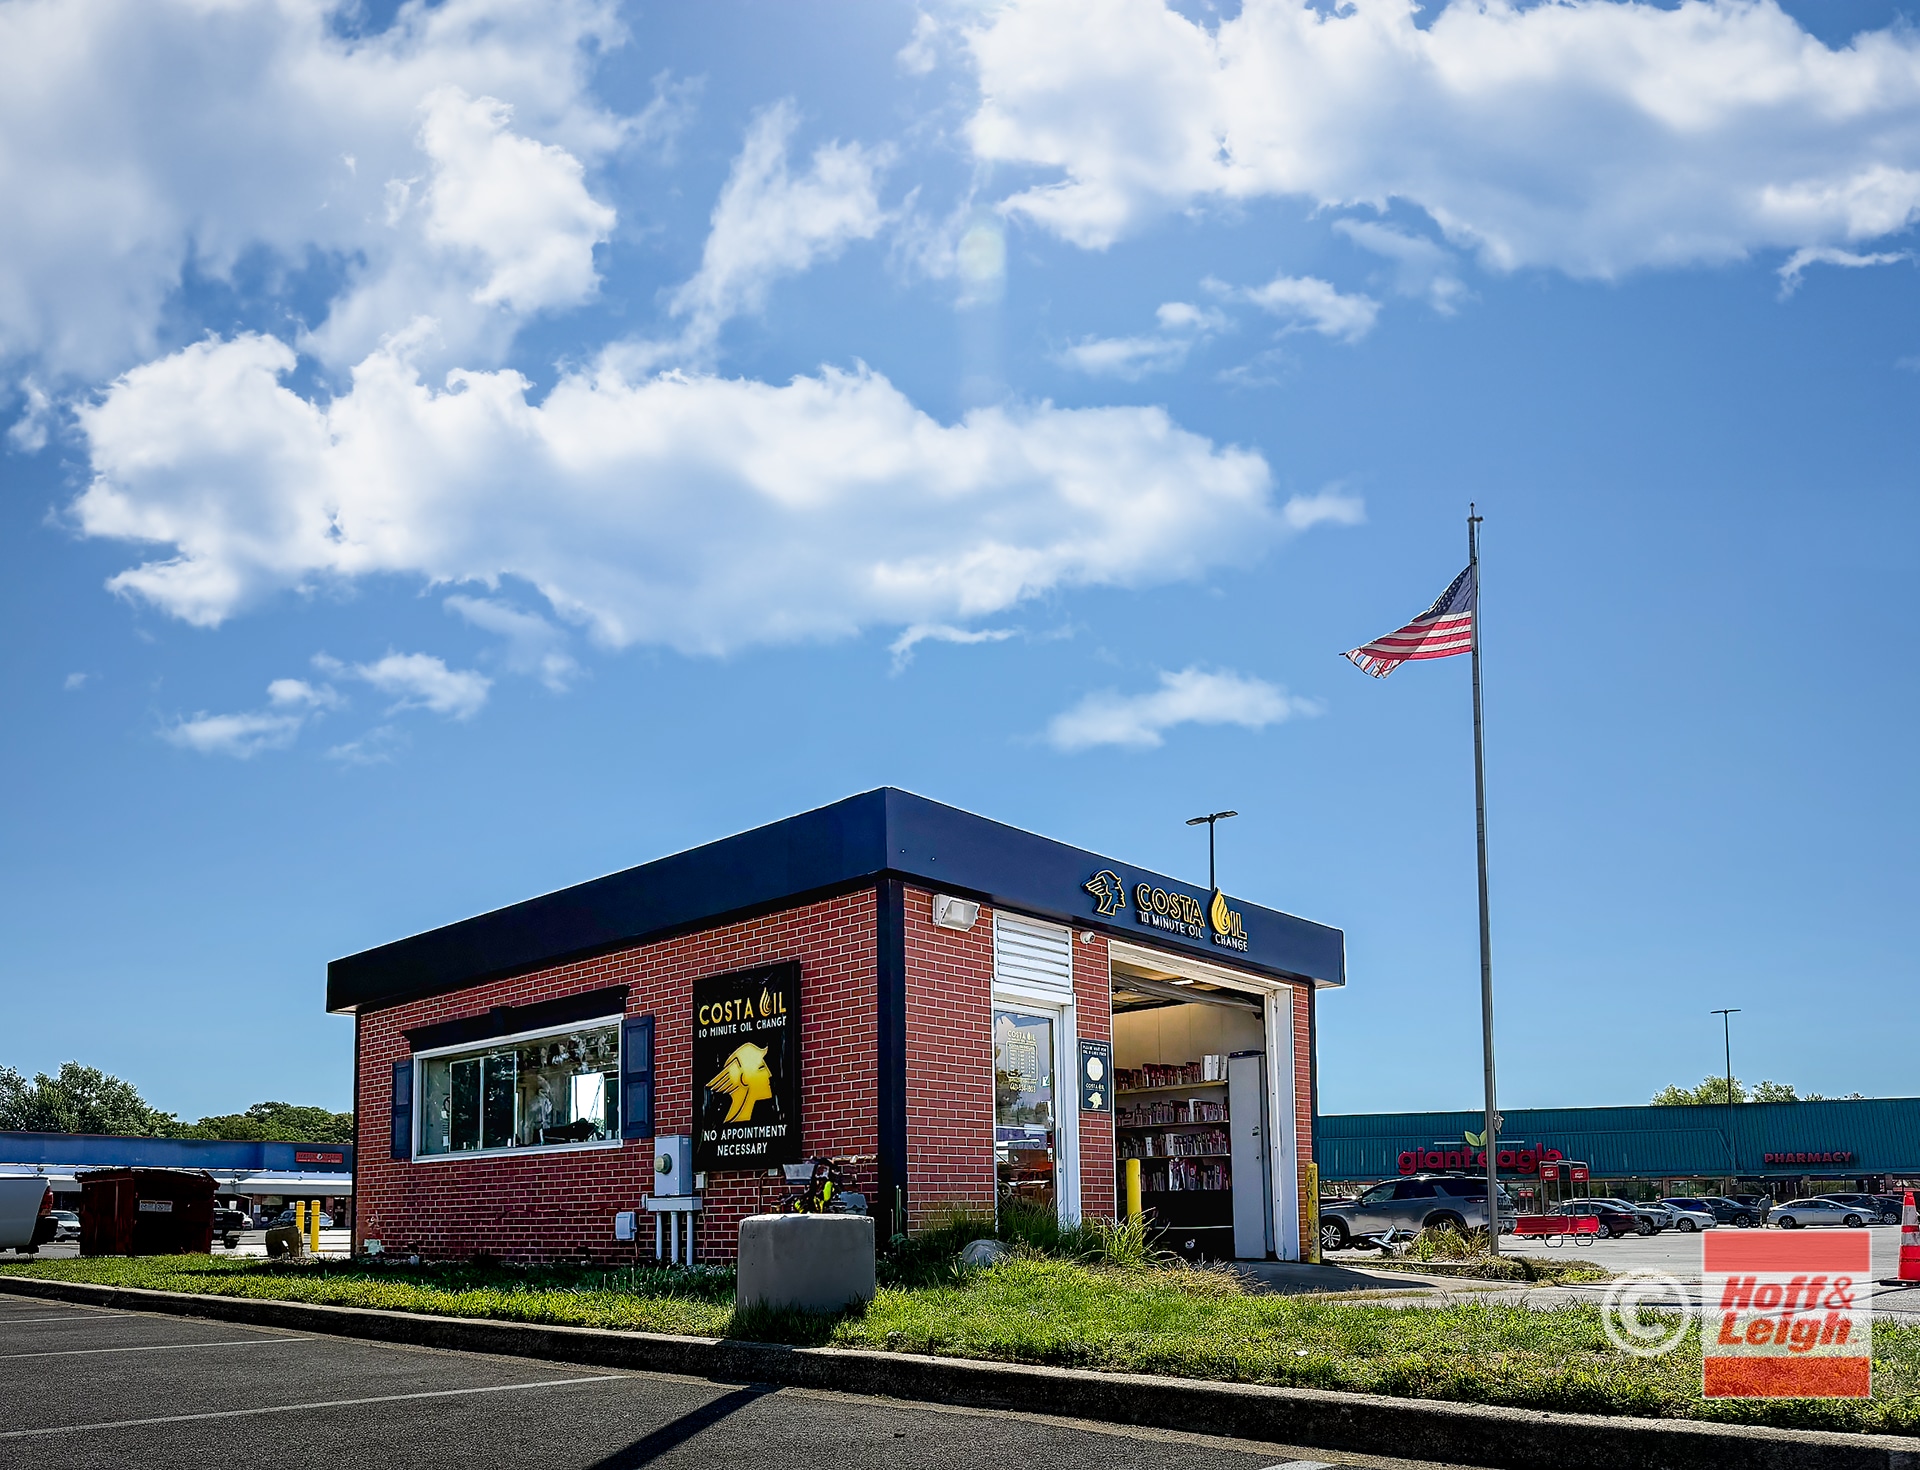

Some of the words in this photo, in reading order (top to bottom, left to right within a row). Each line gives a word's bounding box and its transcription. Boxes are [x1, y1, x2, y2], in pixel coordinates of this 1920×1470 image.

[1136, 882, 1205, 928] COSTA
[1211, 887, 1248, 940] OIL
[1138, 910, 1150, 924] 10
[1152, 913, 1186, 933] MINUTE
[1188, 925, 1204, 939] OIL
[1214, 933, 1249, 952] CHANGE
[699, 997, 754, 1026] COSTA
[759, 987, 787, 1017] OIL
[698, 1027, 708, 1038] 10
[710, 1023, 737, 1037] MINUTE
[740, 1021, 753, 1033] OIL
[1007, 1030, 1026, 1041] COSTA
[703, 1129, 718, 1142] NO
[717, 1142, 768, 1157] NECESSARY
[1764, 1151, 1852, 1163] PHARMACY
[1398, 1146, 1473, 1175] giant
